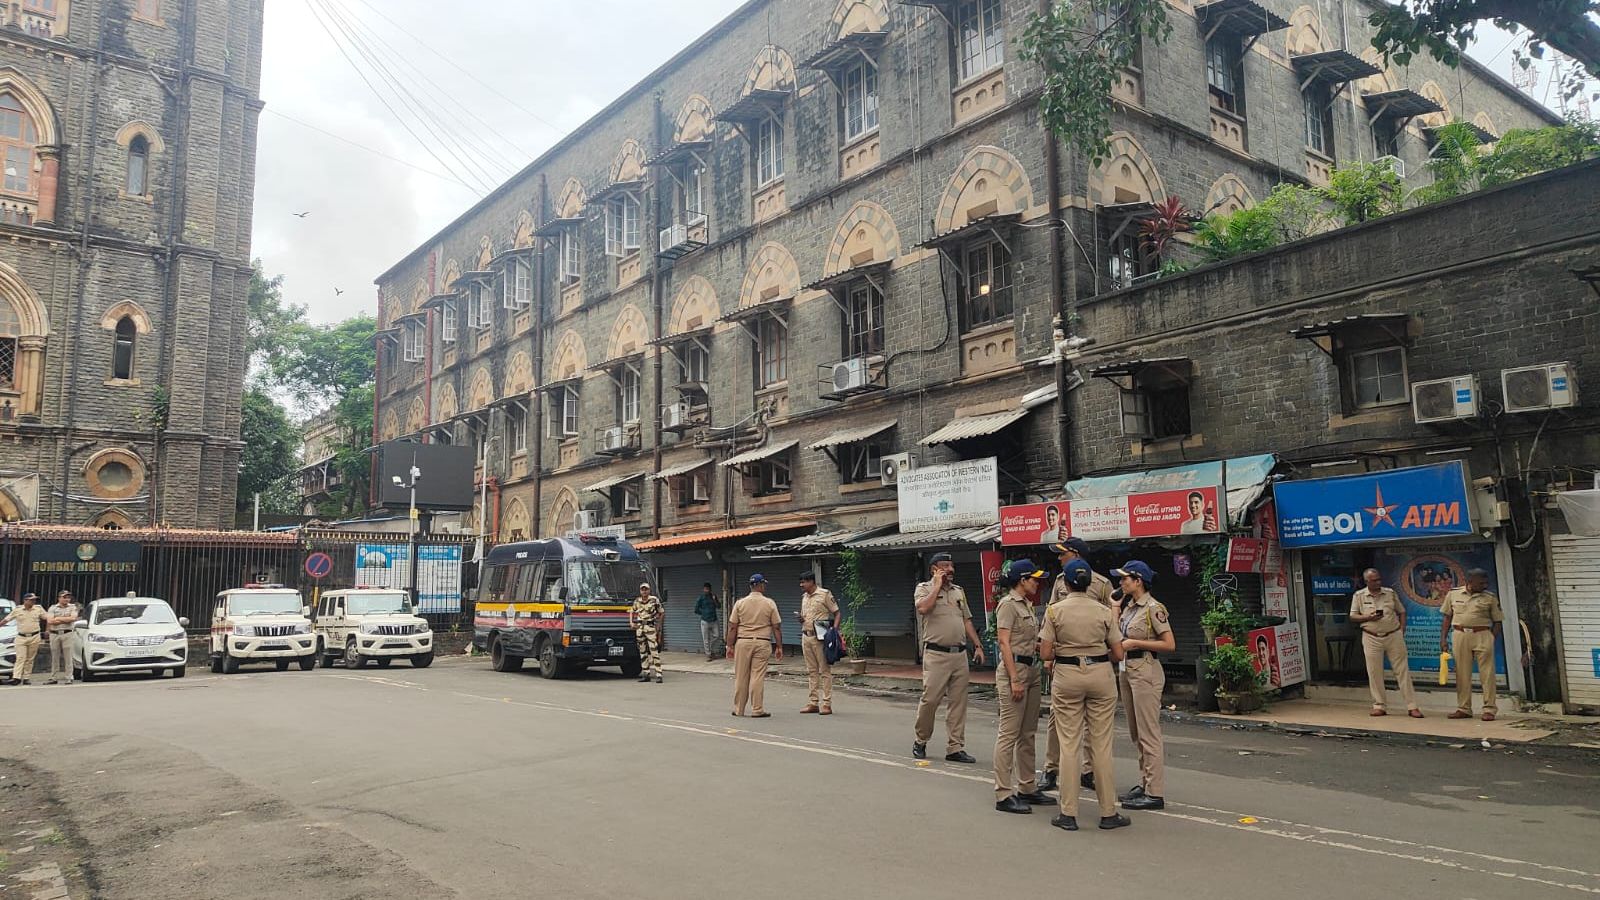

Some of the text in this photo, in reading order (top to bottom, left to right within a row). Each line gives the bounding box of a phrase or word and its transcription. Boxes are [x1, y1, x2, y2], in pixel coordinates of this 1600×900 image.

[900, 474, 923, 483] ADVOCATES
[924, 470, 951, 480] ASSOCIATION
[952, 468, 958, 477] OF
[959, 465, 979, 476] WESTERN
[981, 464, 993, 473] INDIA
[1133, 503, 1160, 515] Coca-Cola
[1003, 515, 1024, 526] Coca-Cola
[1317, 502, 1460, 535] BOI ATM
[32, 561, 137, 572] BOMBAY HIGH COURT
[1314, 580, 1351, 589] Bank of India
[1283, 667, 1303, 677] CANTEEN
